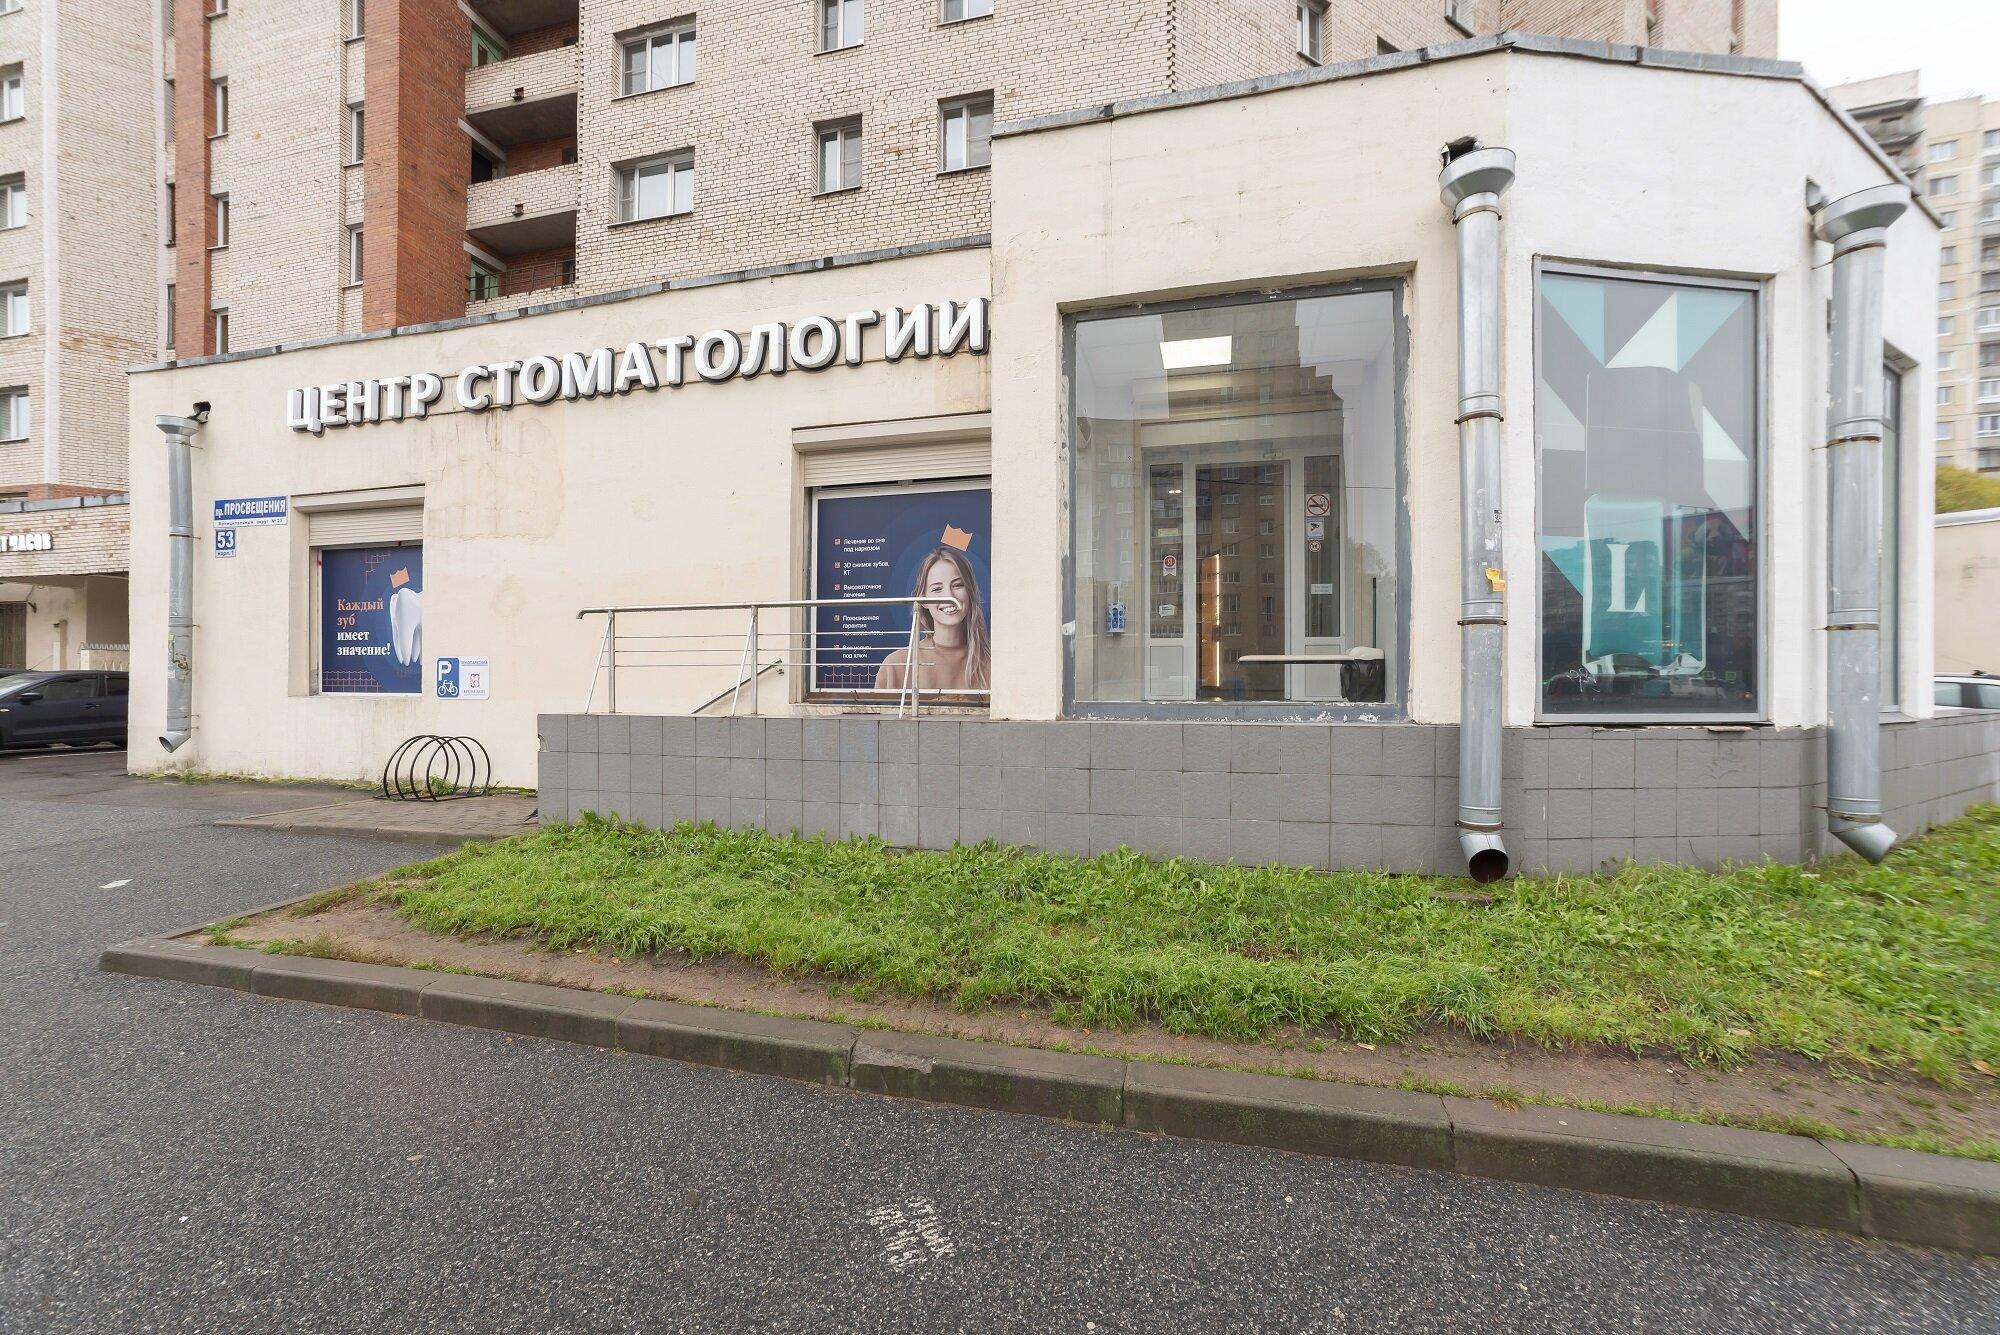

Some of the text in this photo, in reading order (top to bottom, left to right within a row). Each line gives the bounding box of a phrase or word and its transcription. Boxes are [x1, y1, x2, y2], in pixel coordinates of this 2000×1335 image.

[287, 297, 987, 436] ЦЕНТР СТОМАТОЛОГИИ
[215, 499, 286, 518] пр. ПРОСВЕЩЕНИЯ
[9, 533, 52, 551] ЧАСОВ
[217, 531, 234, 549] 53
[854, 545, 881, 553] наркозом
[337, 598, 384, 613] Каждый
[336, 613, 356, 630] зуб
[337, 631, 370, 641] имеет
[336, 643, 391, 656] значение!
